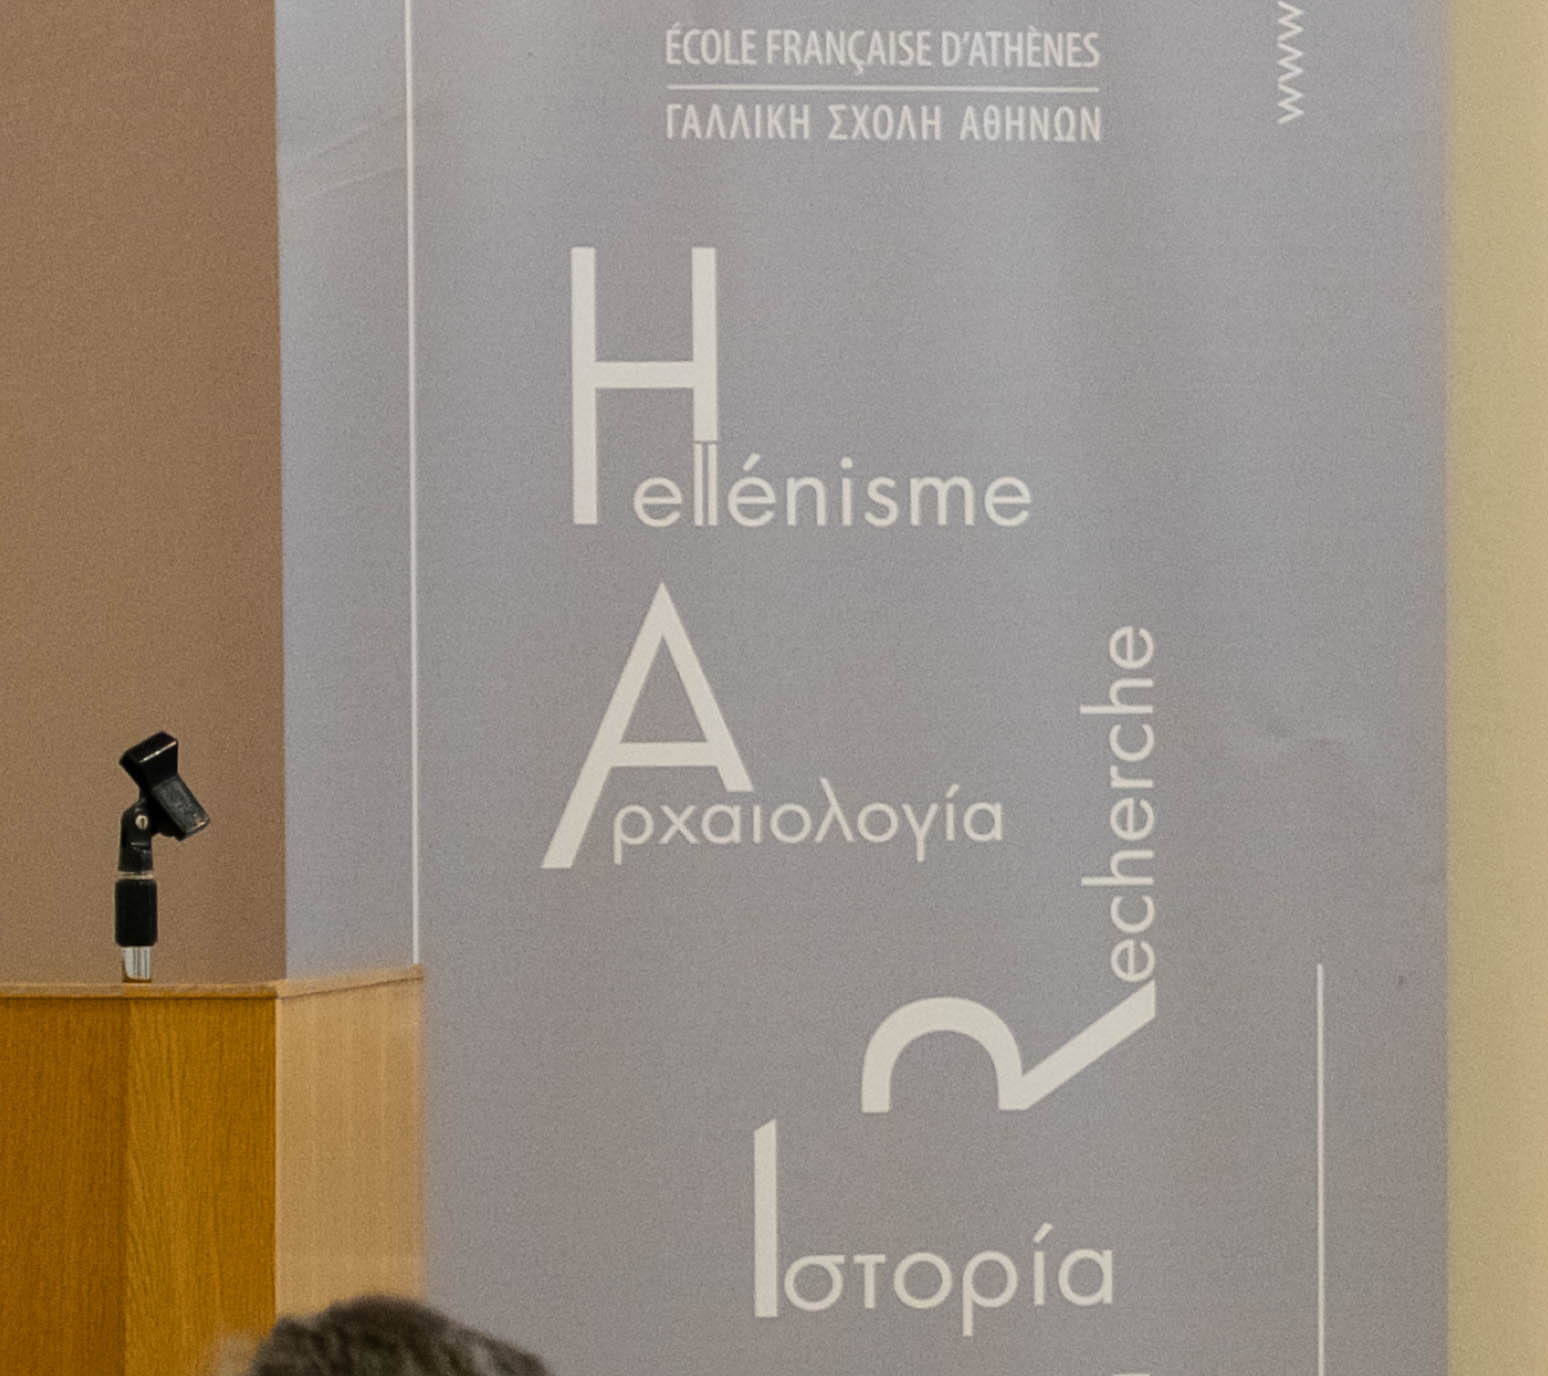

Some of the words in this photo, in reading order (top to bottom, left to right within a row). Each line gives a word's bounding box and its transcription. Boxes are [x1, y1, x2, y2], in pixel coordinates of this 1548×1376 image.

[665, 21, 758, 66] ÉCOLE
[766, 27, 933, 75] FRANÇAISE
[665, 103, 811, 141] ΓΑΛΛΙΚΗ
[827, 103, 942, 142] ΣΧΟΛΗ
[959, 104, 1101, 143] ΑΘΗΝΩΝ
[571, 246, 1033, 527] Hellénisme
